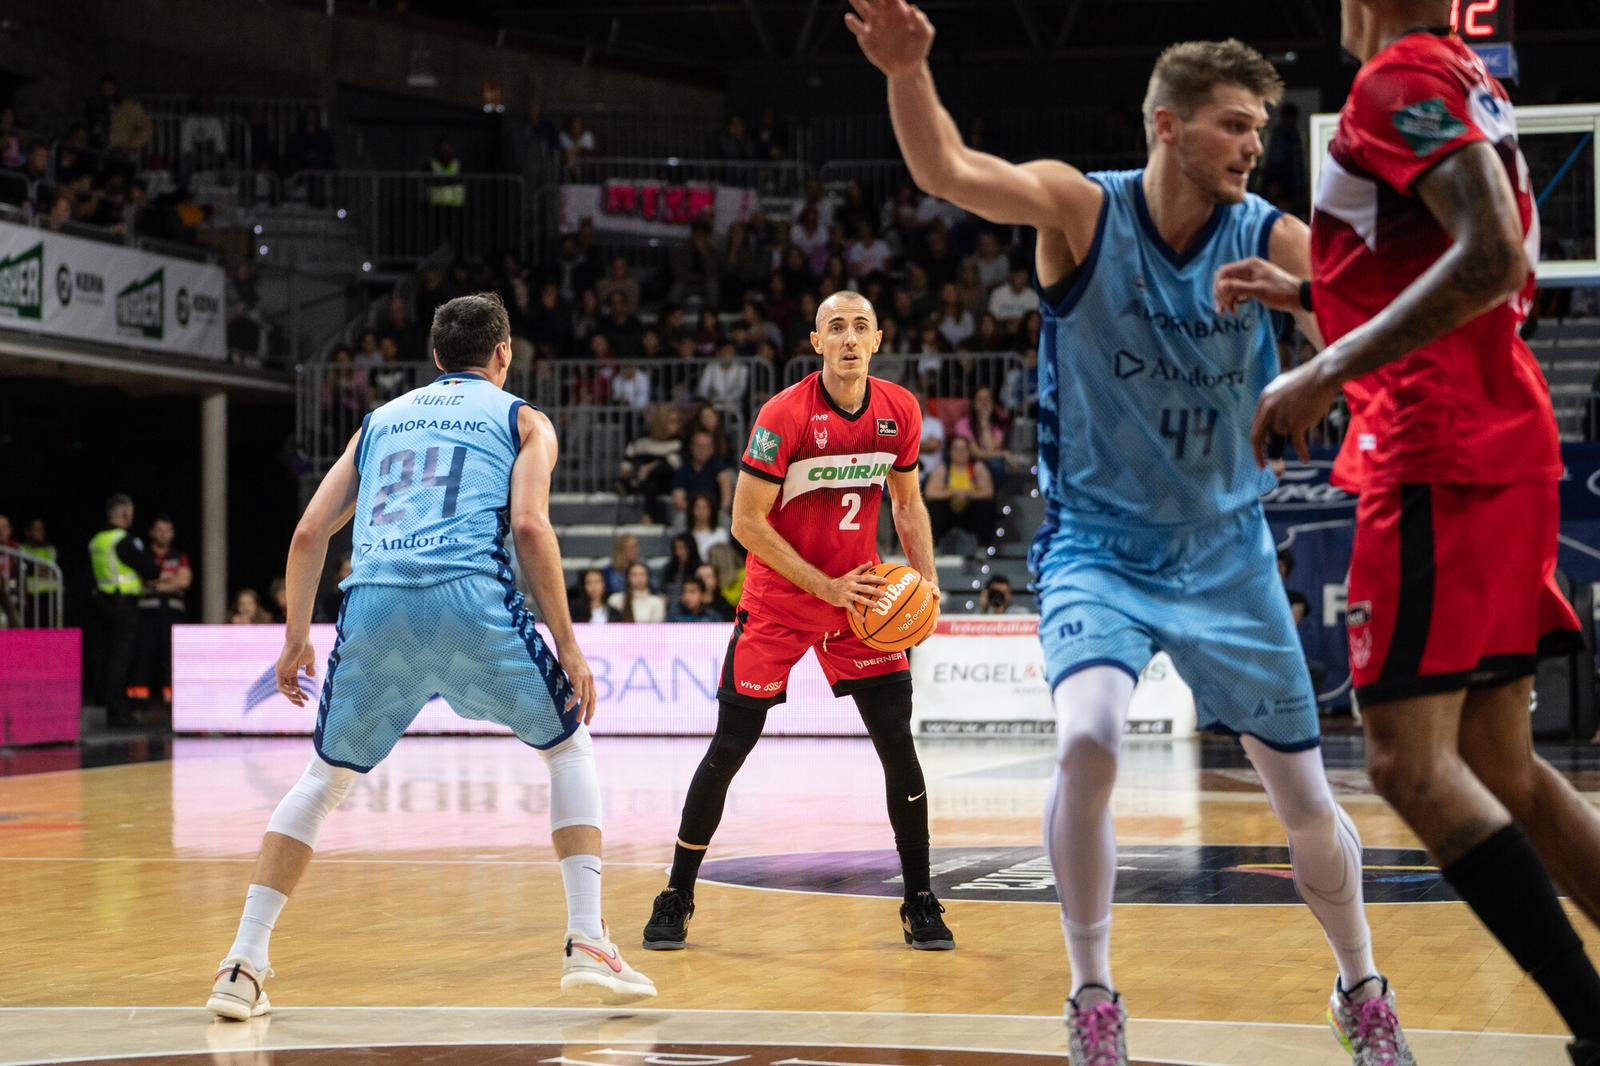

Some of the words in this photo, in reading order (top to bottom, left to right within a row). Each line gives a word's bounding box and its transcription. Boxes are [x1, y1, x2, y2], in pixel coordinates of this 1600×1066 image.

[390, 419, 488, 436] MORABANC
[1159, 408, 1219, 460] 44
[369, 446, 468, 527] 24
[839, 493, 862, 531] 2
[375, 533, 460, 551] Andorra
[872, 572, 917, 617] Wilson
[897, 617, 914, 633] liga
[862, 652, 903, 667] BERNER
[741, 680, 761, 691] vive
